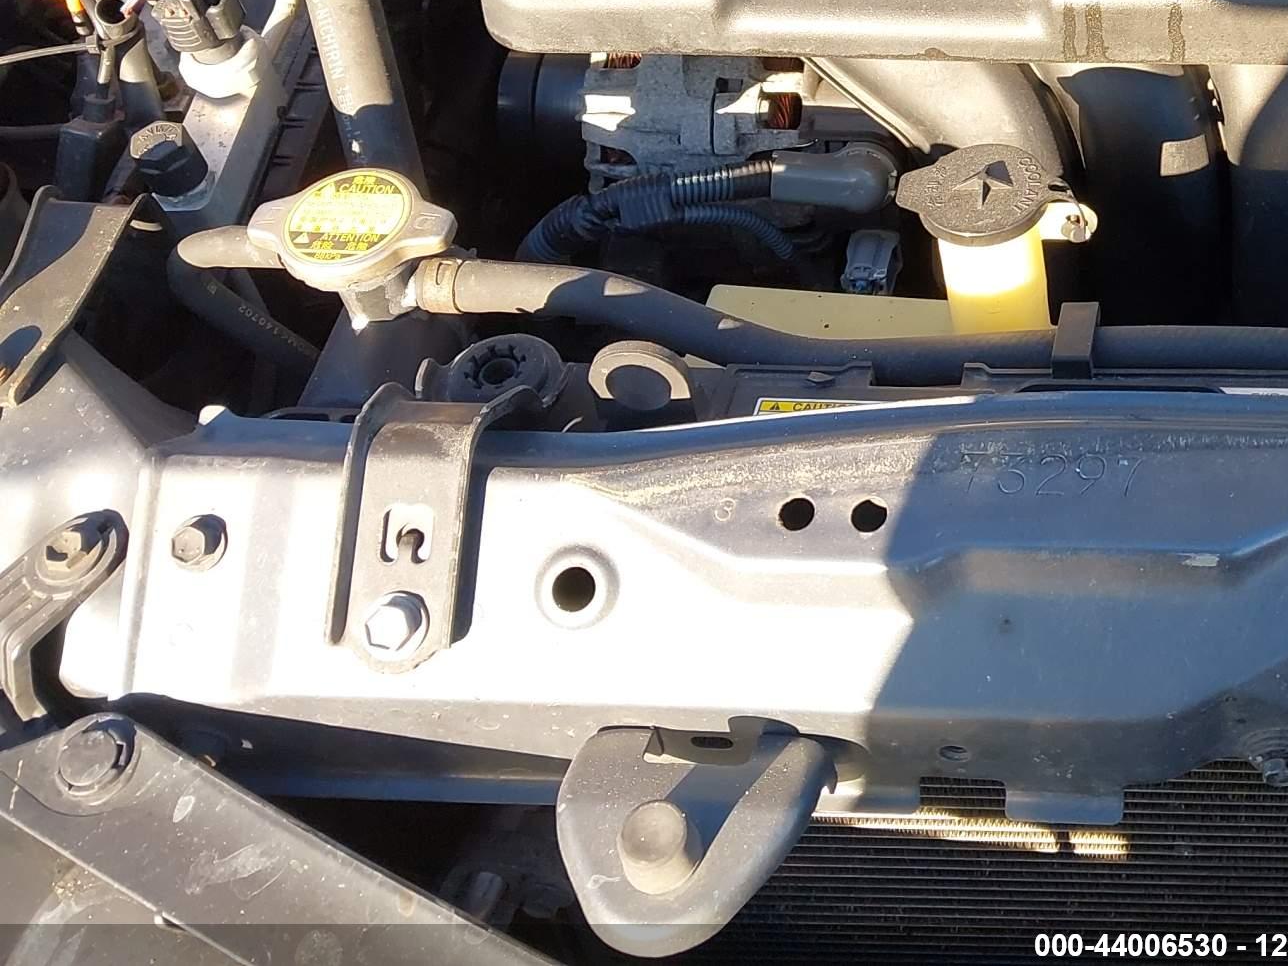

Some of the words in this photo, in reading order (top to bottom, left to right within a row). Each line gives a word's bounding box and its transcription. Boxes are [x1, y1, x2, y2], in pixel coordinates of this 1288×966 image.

[339, 184, 395, 195] CAUTION
[1012, 155, 1042, 215] COOLANT
[320, 233, 380, 243] ATTENTION
